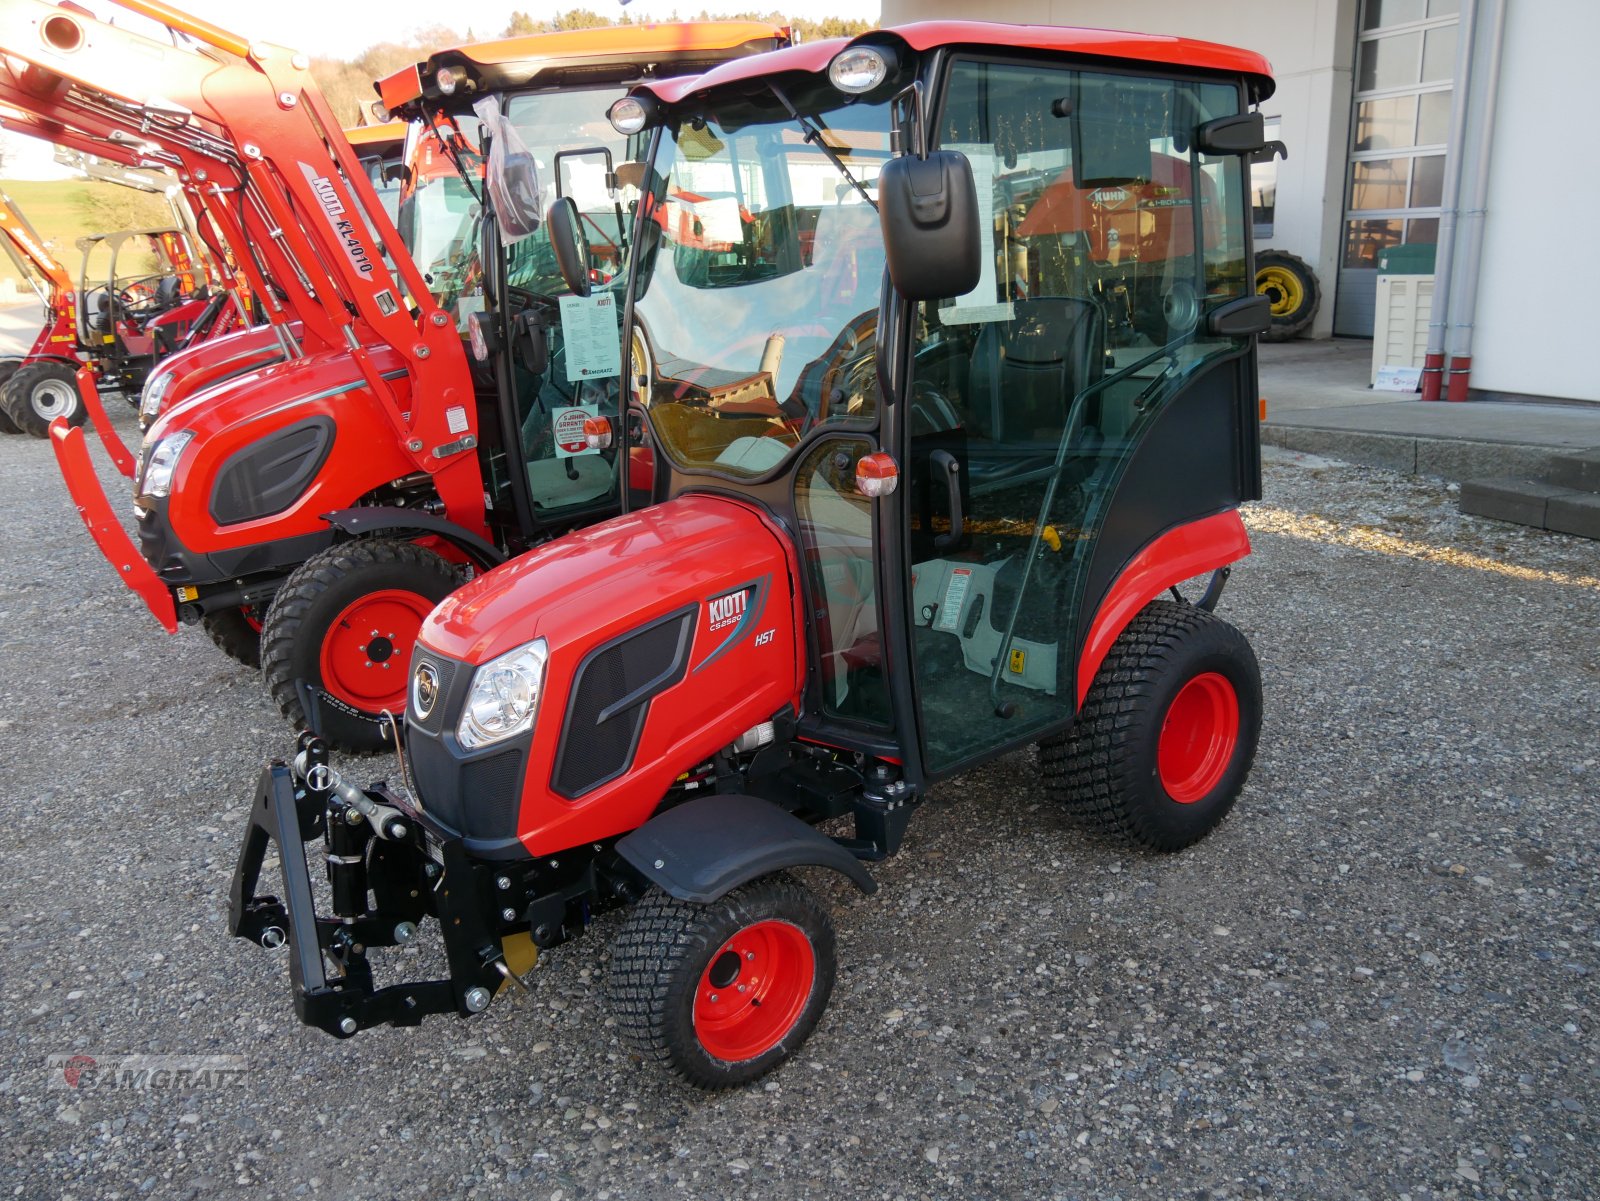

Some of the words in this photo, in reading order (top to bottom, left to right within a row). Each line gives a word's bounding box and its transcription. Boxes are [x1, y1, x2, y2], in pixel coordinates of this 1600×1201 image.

[1094, 191, 1126, 201] KUHN
[312, 177, 346, 216] KIOTI
[337, 220, 373, 273] KL4010
[709, 590, 747, 624] KIOTI
[709, 614, 742, 632] CS2520
[754, 628, 776, 647] HST
